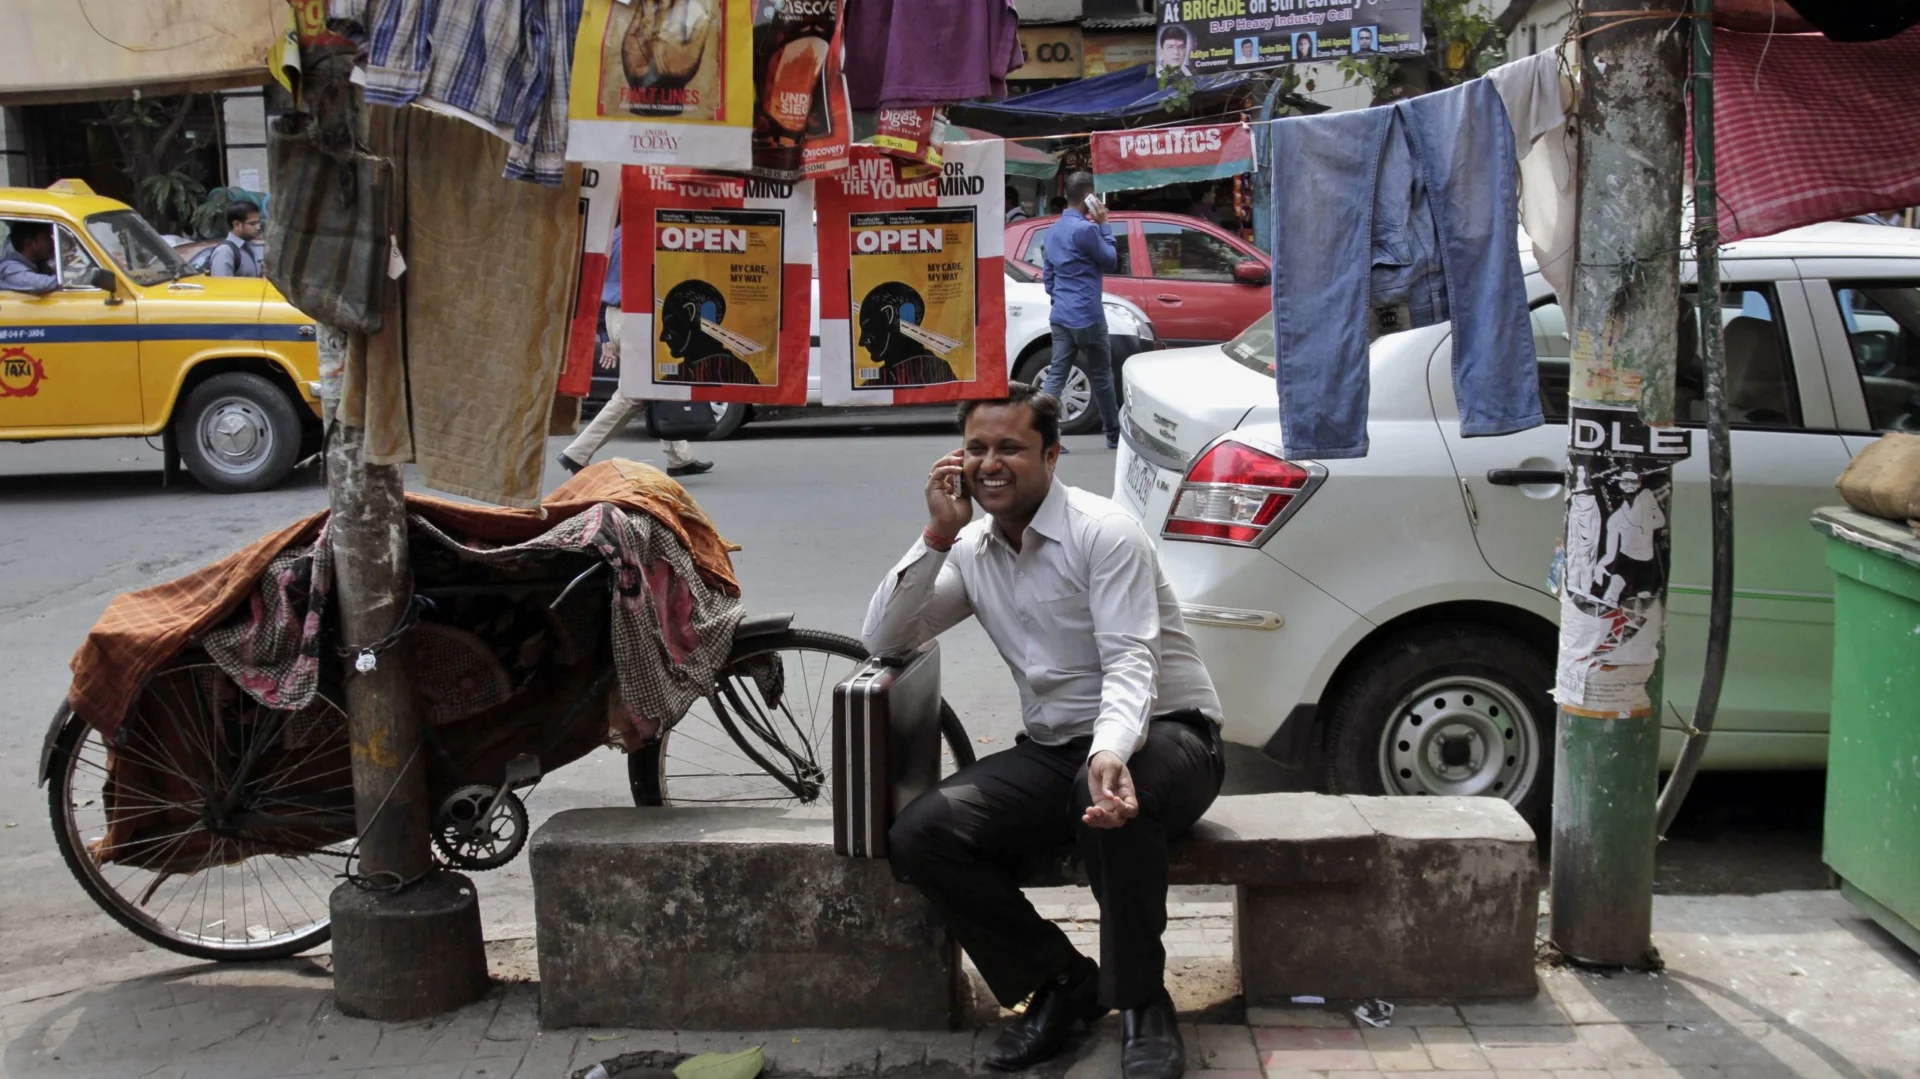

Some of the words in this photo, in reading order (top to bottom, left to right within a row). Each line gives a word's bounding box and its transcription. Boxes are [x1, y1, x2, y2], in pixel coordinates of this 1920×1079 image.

[1164, 3, 1179, 23] At
[1183, 0, 1246, 20] BRIGADE
[1250, 0, 1266, 13] on
[1210, 20, 1235, 33] BJP
[1236, 17, 1274, 30] Heavy
[1275, 13, 1325, 27] Industry
[1327, 8, 1352, 21] Cell
[1037, 42, 1073, 62] CO.
[1195, 59, 1229, 67] Convener
[620, 87, 657, 103] FAULT
[662, 89, 699, 104] LINES
[780, 92, 810, 104] UND
[880, 109, 922, 128] Digest
[630, 135, 681, 150] TODAY
[803, 144, 845, 158] Discovery
[1119, 128, 1222, 159] POLITICS
[649, 175, 675, 191] THE
[743, 178, 793, 199] MIND
[841, 179, 869, 195] THE
[937, 175, 984, 197] MIND
[661, 227, 747, 250] OPEN
[856, 228, 943, 252] OPEN
[730, 264, 743, 273] MY
[744, 264, 768, 274] CARE,
[927, 263, 940, 272] MY
[941, 262, 964, 273] CARE,
[730, 274, 743, 283] MY
[744, 274, 762, 283] WAY
[927, 273, 941, 282] MY
[941, 272, 958, 281] WAY
[4, 359, 32, 377] TAXI
